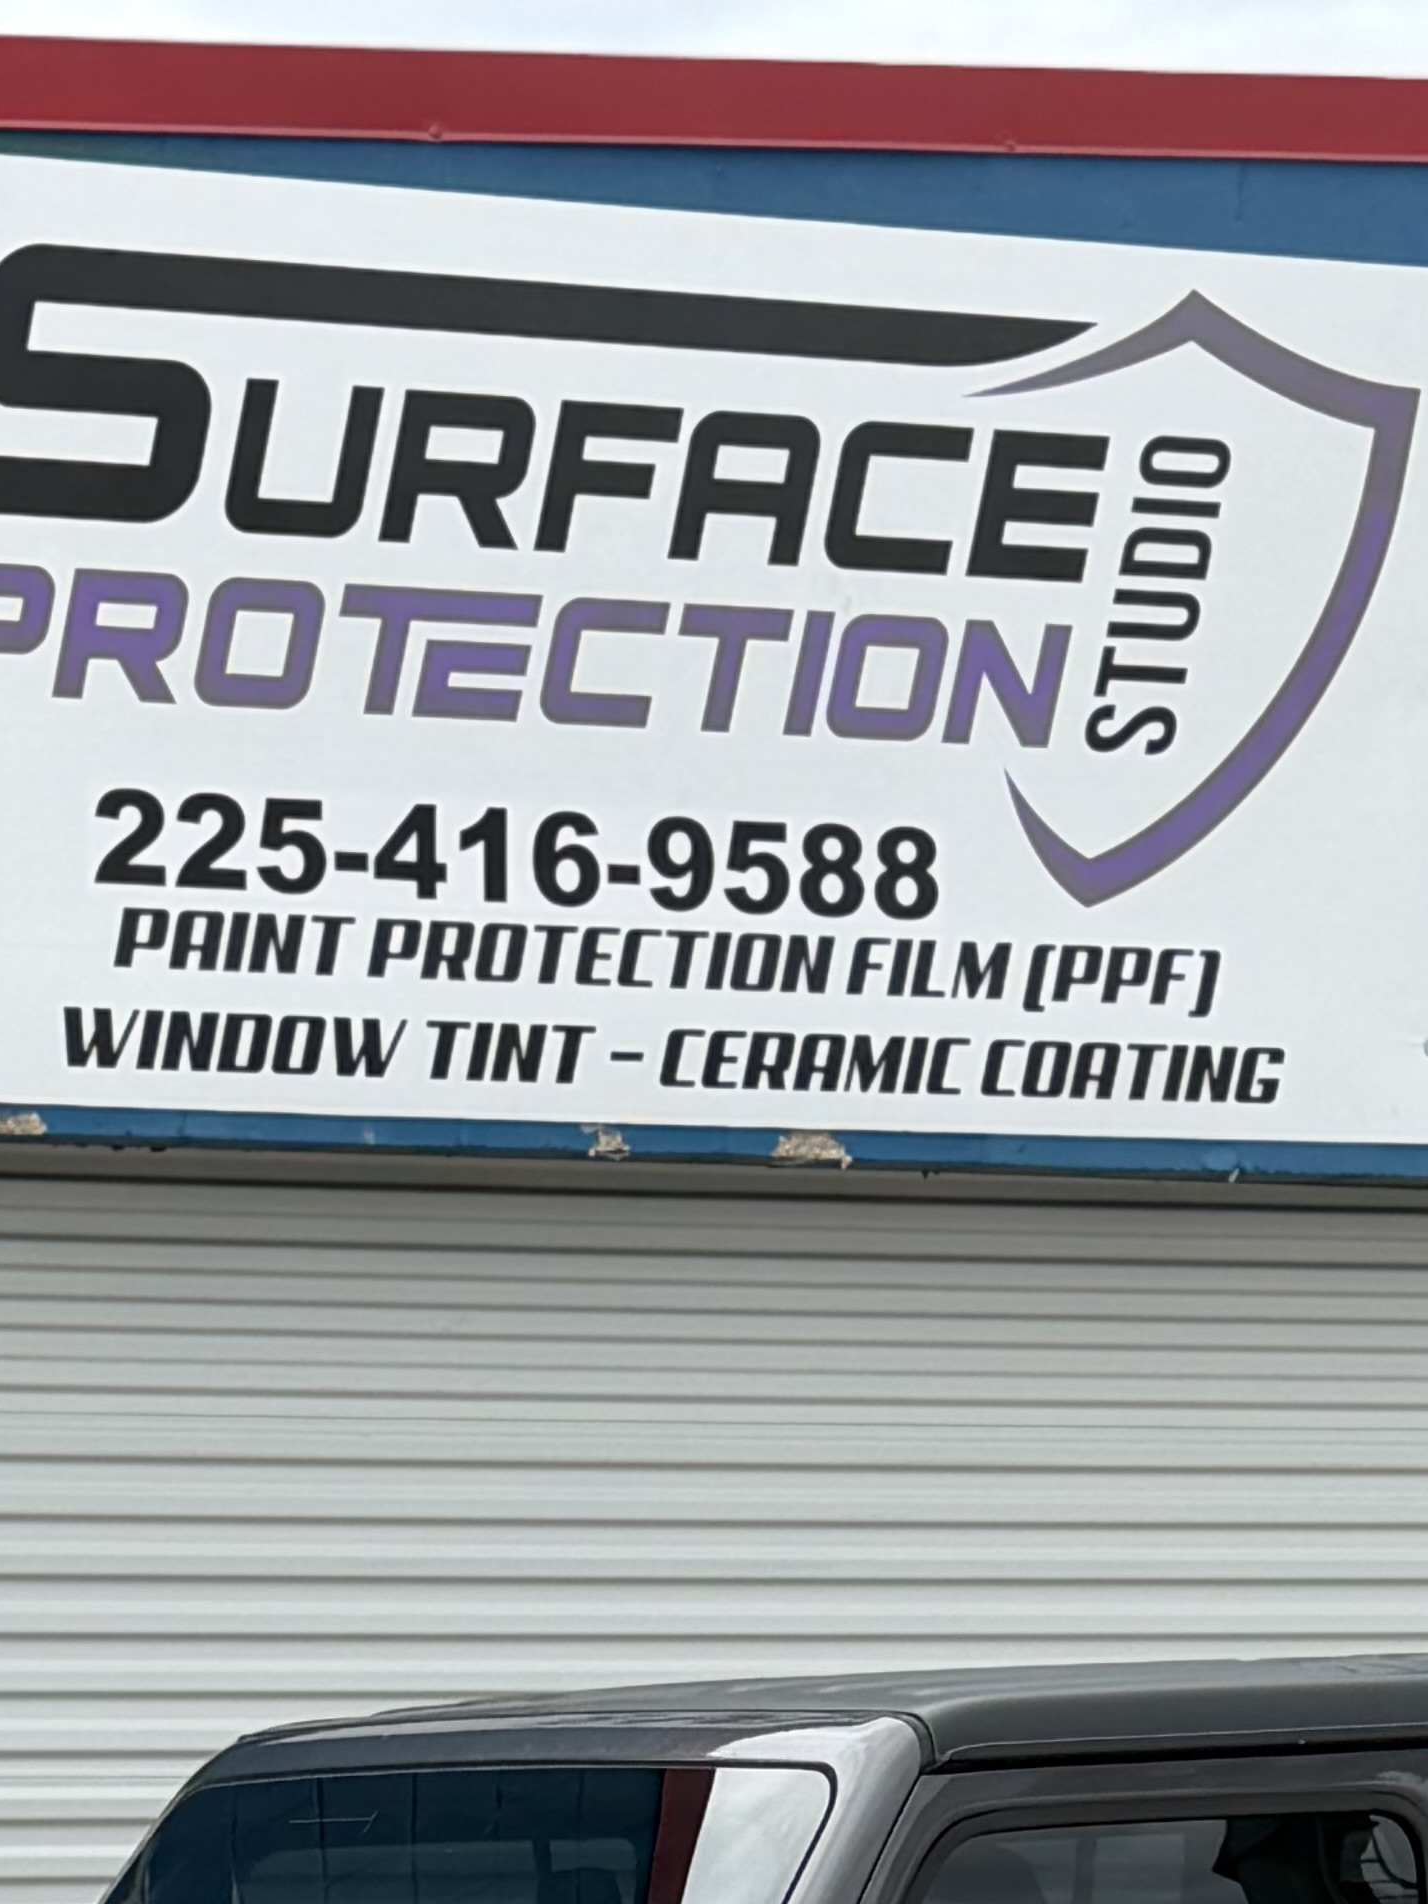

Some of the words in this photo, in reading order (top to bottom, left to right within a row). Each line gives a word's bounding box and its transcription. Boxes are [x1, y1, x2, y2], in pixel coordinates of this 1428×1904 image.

[1085, 436, 1230, 754] STUDIO
[95, 789, 938, 920] 225-416-9588
[114, 908, 355, 975] PAINT
[368, 919, 834, 993] PROTECTION
[847, 938, 1011, 999] FILM
[64, 1007, 407, 1077] WINDOW
[427, 1021, 596, 1083] TINT
[611, 1050, 644, 1063] -
[660, 1029, 970, 1094] CERAMIC
[981, 1040, 1284, 1103] COATING
